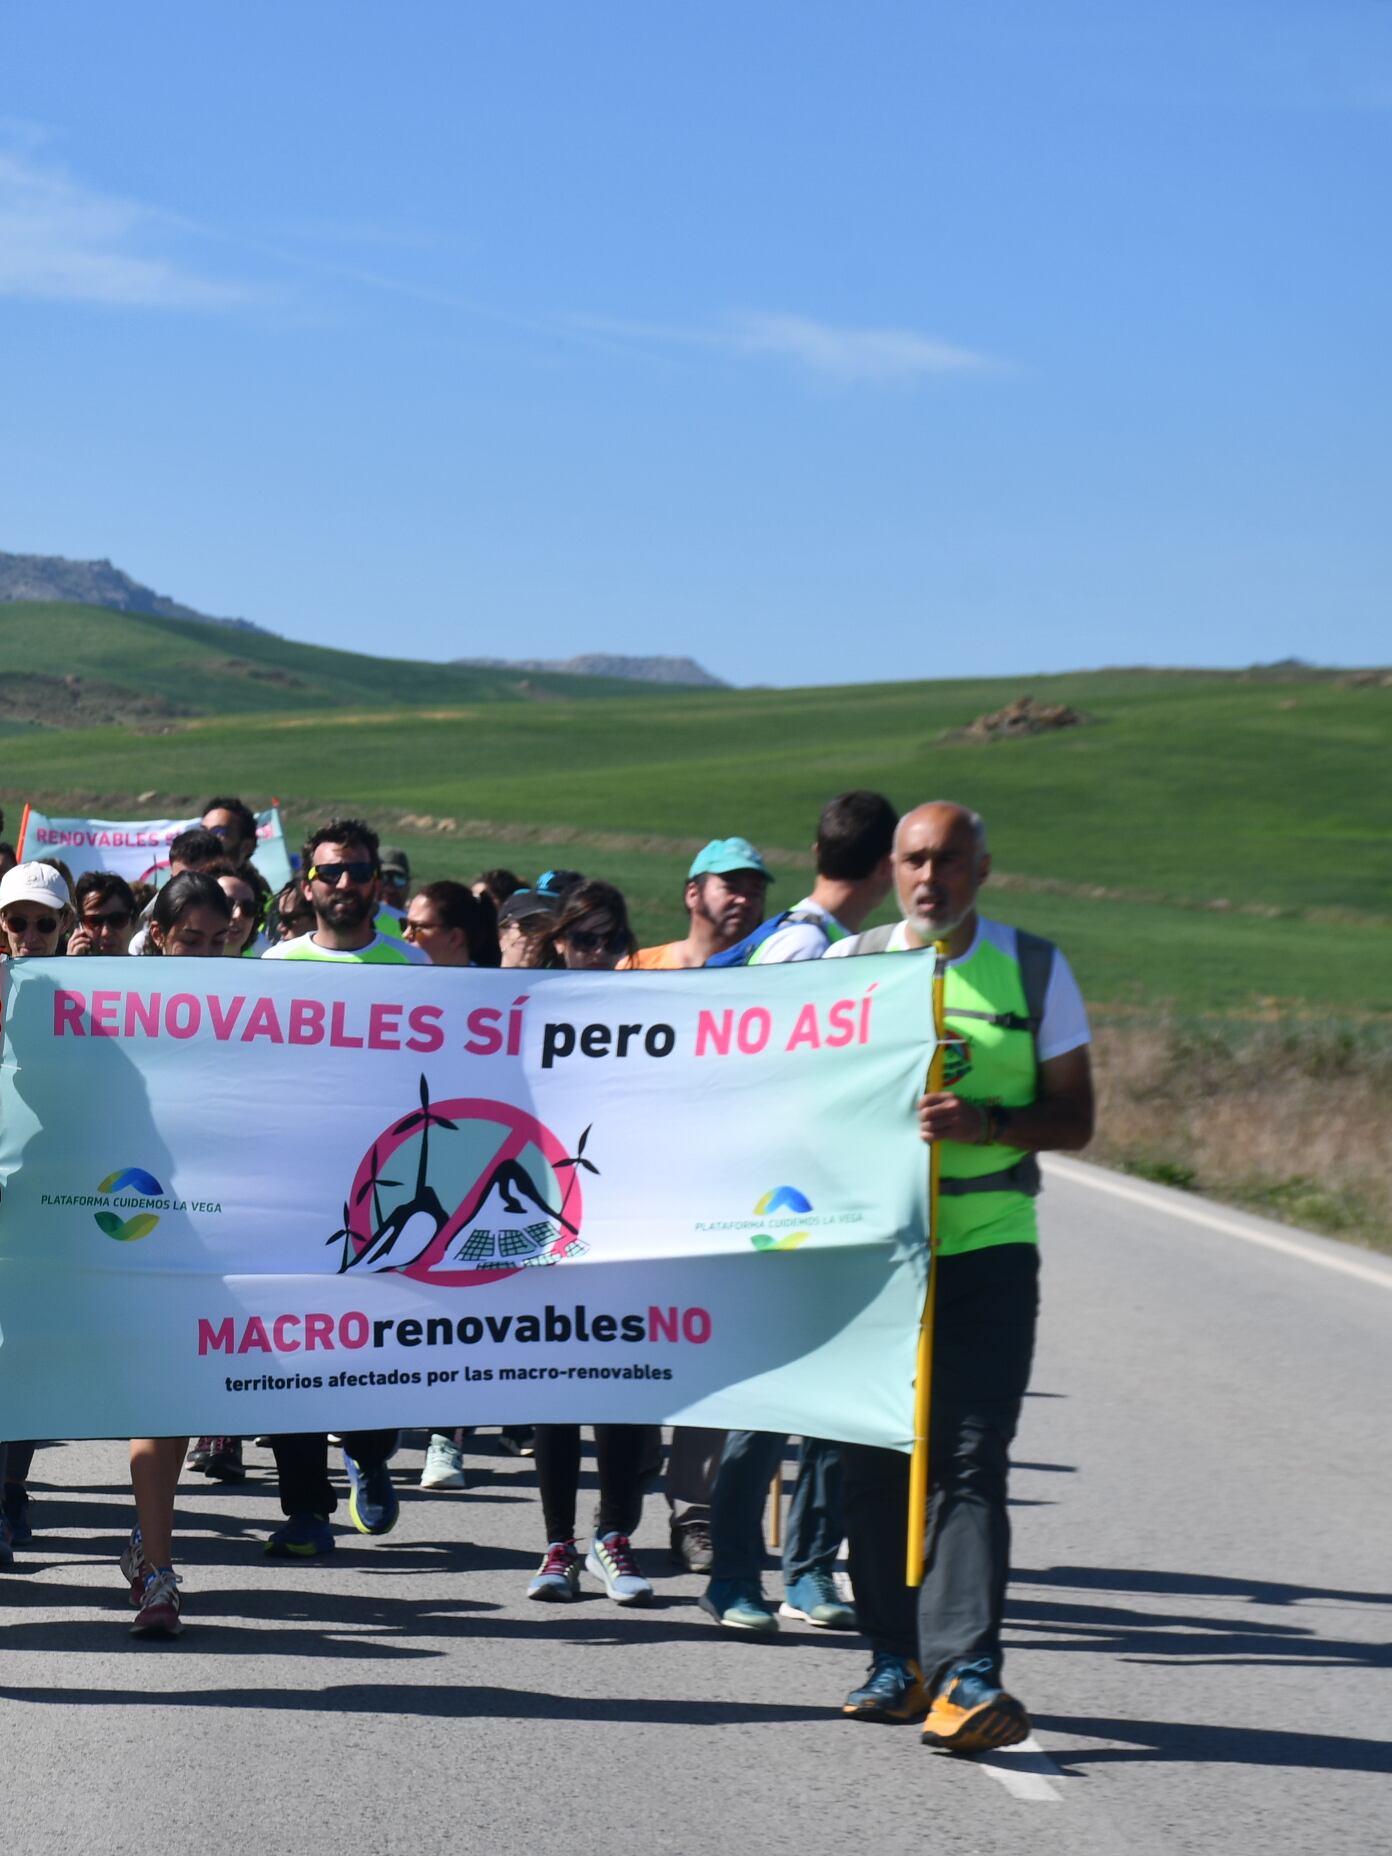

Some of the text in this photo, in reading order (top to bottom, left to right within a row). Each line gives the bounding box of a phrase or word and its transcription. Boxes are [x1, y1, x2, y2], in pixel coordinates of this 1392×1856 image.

[36, 828, 158, 847] RENOVABLES
[53, 982, 879, 1069] RENOVABLES SÍ pero NO ASÍ
[41, 1194, 222, 1213] PLATAFORMA CUIDEMOS LA VEGA
[695, 1213, 864, 1232] PLATAFORMA CUIDEMOS LA VEGA
[197, 1305, 713, 1356] MACROrenovablesNO
[225, 1364, 674, 1392] territorios afectados por las macro-renovables
